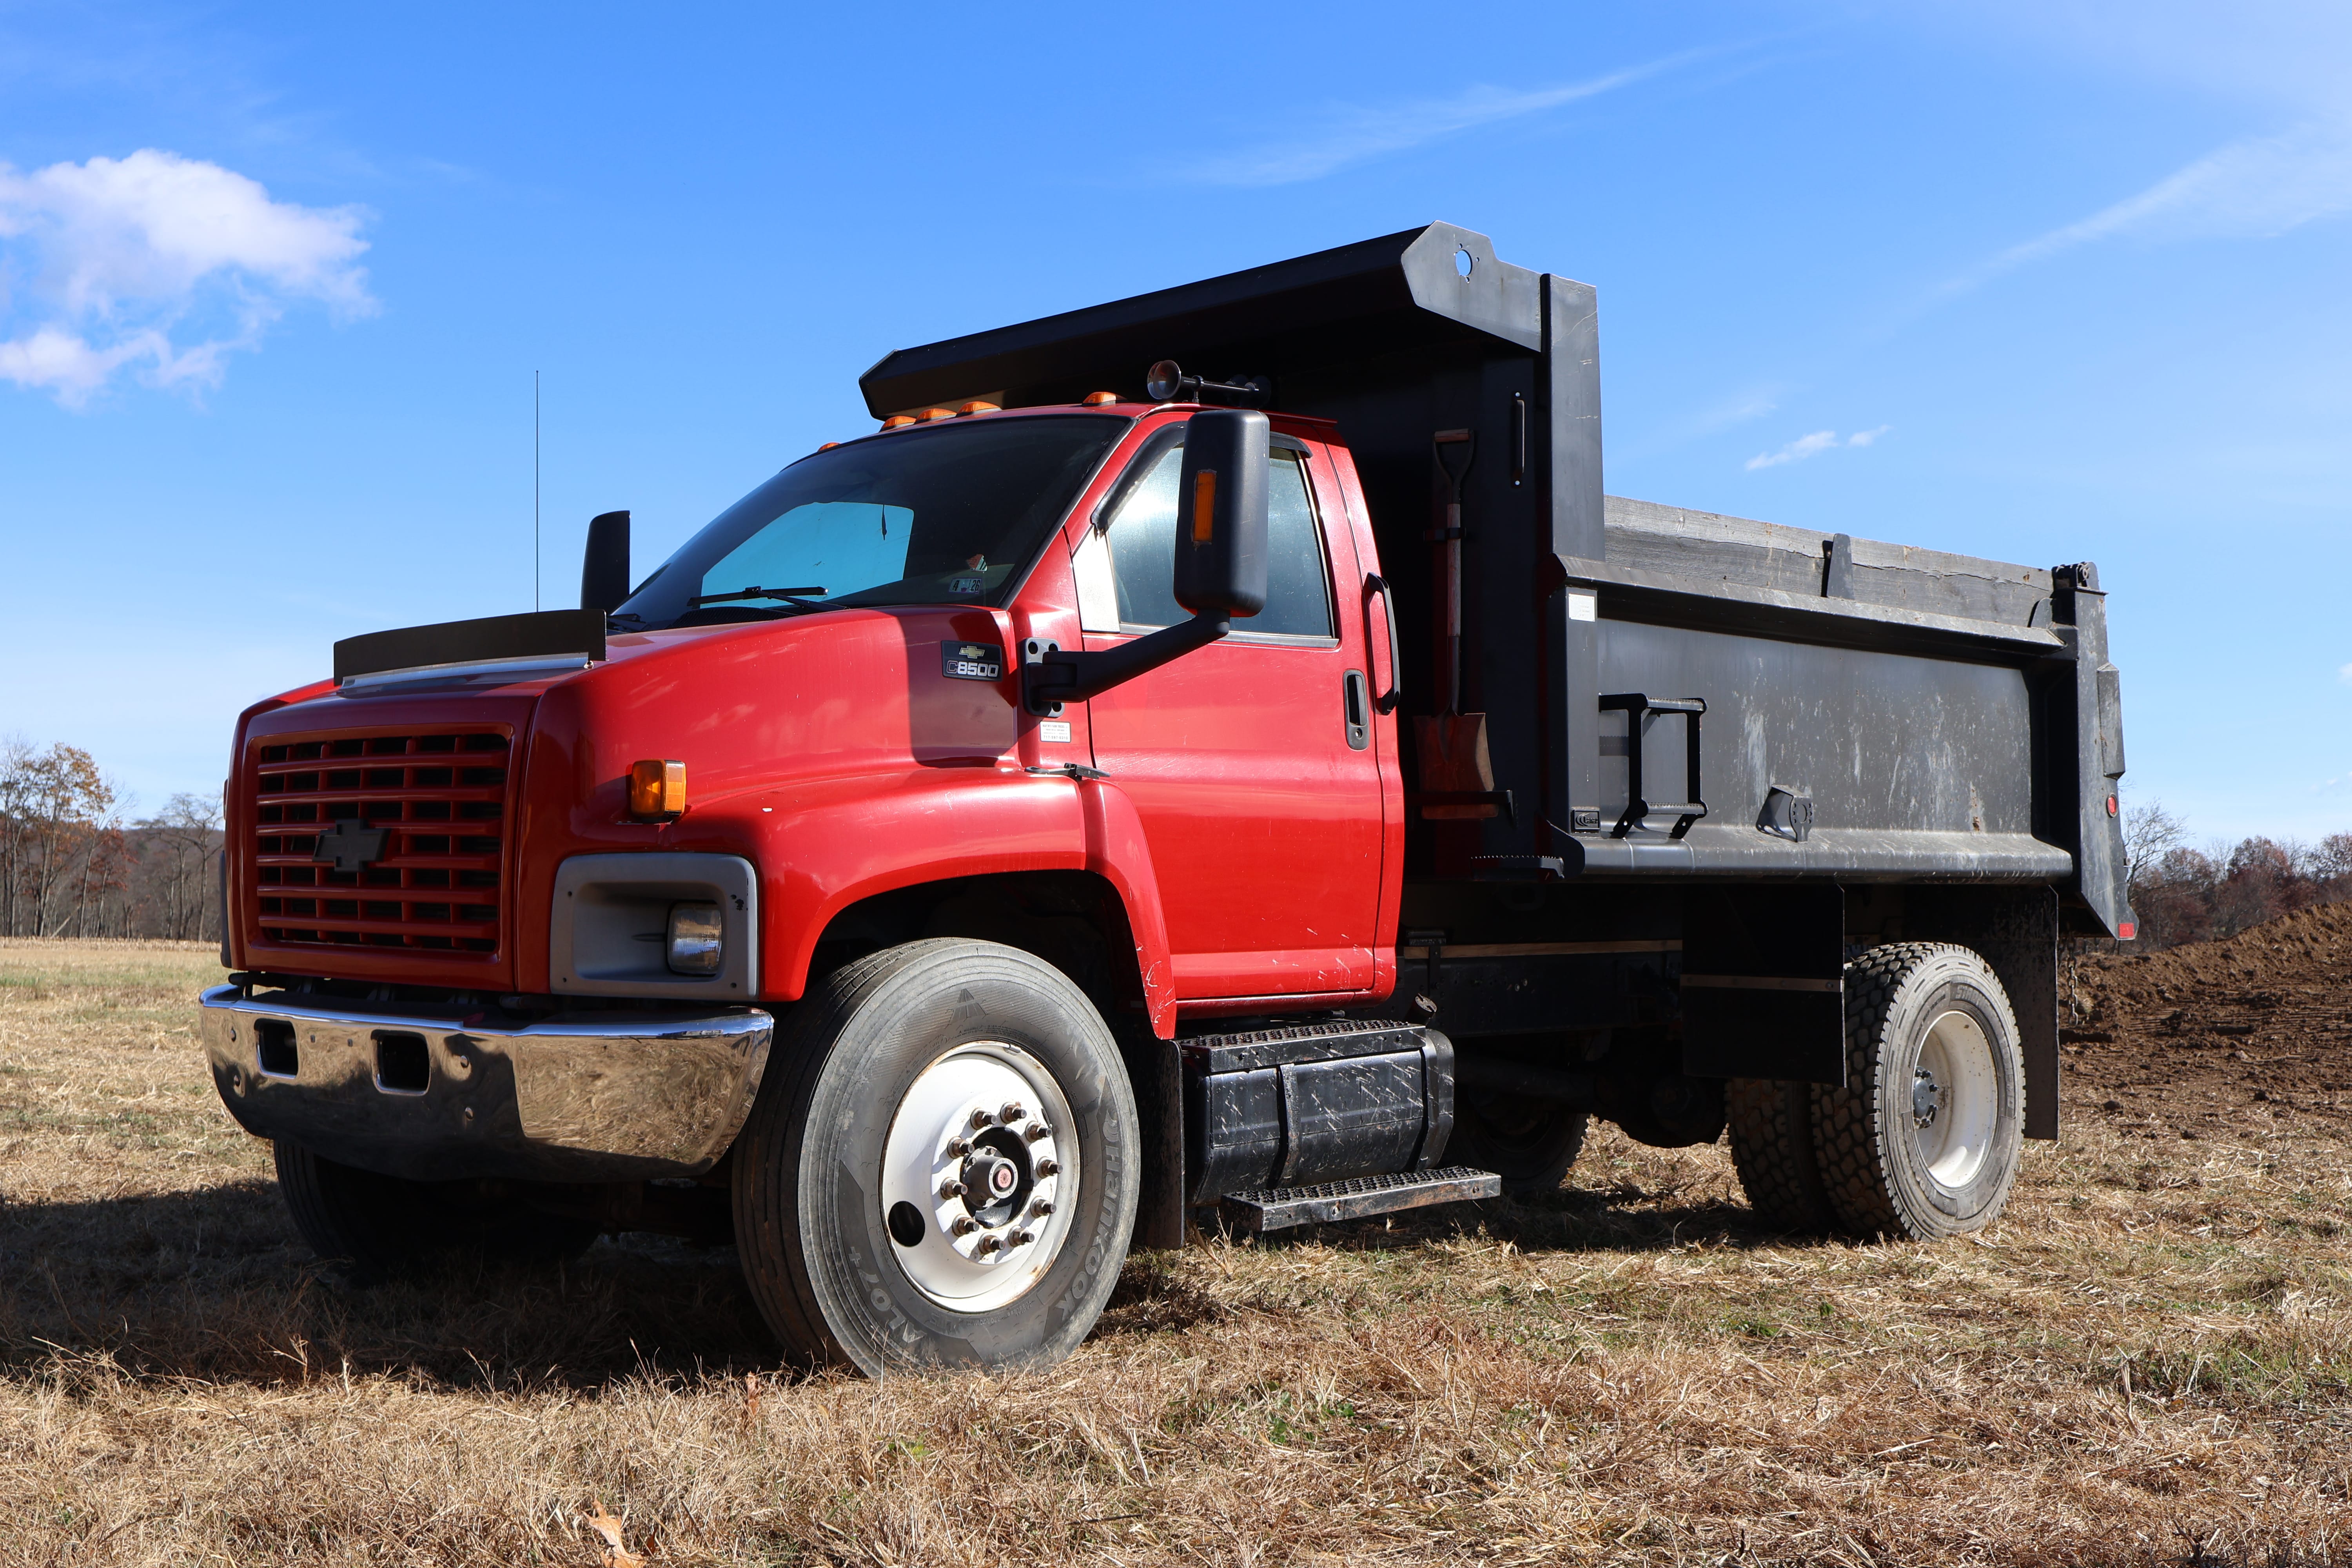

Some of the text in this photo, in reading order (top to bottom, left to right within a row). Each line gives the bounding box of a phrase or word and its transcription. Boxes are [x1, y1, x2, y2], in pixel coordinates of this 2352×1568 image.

[952, 580, 980, 591] 4 26
[946, 660, 999, 677] C8500
